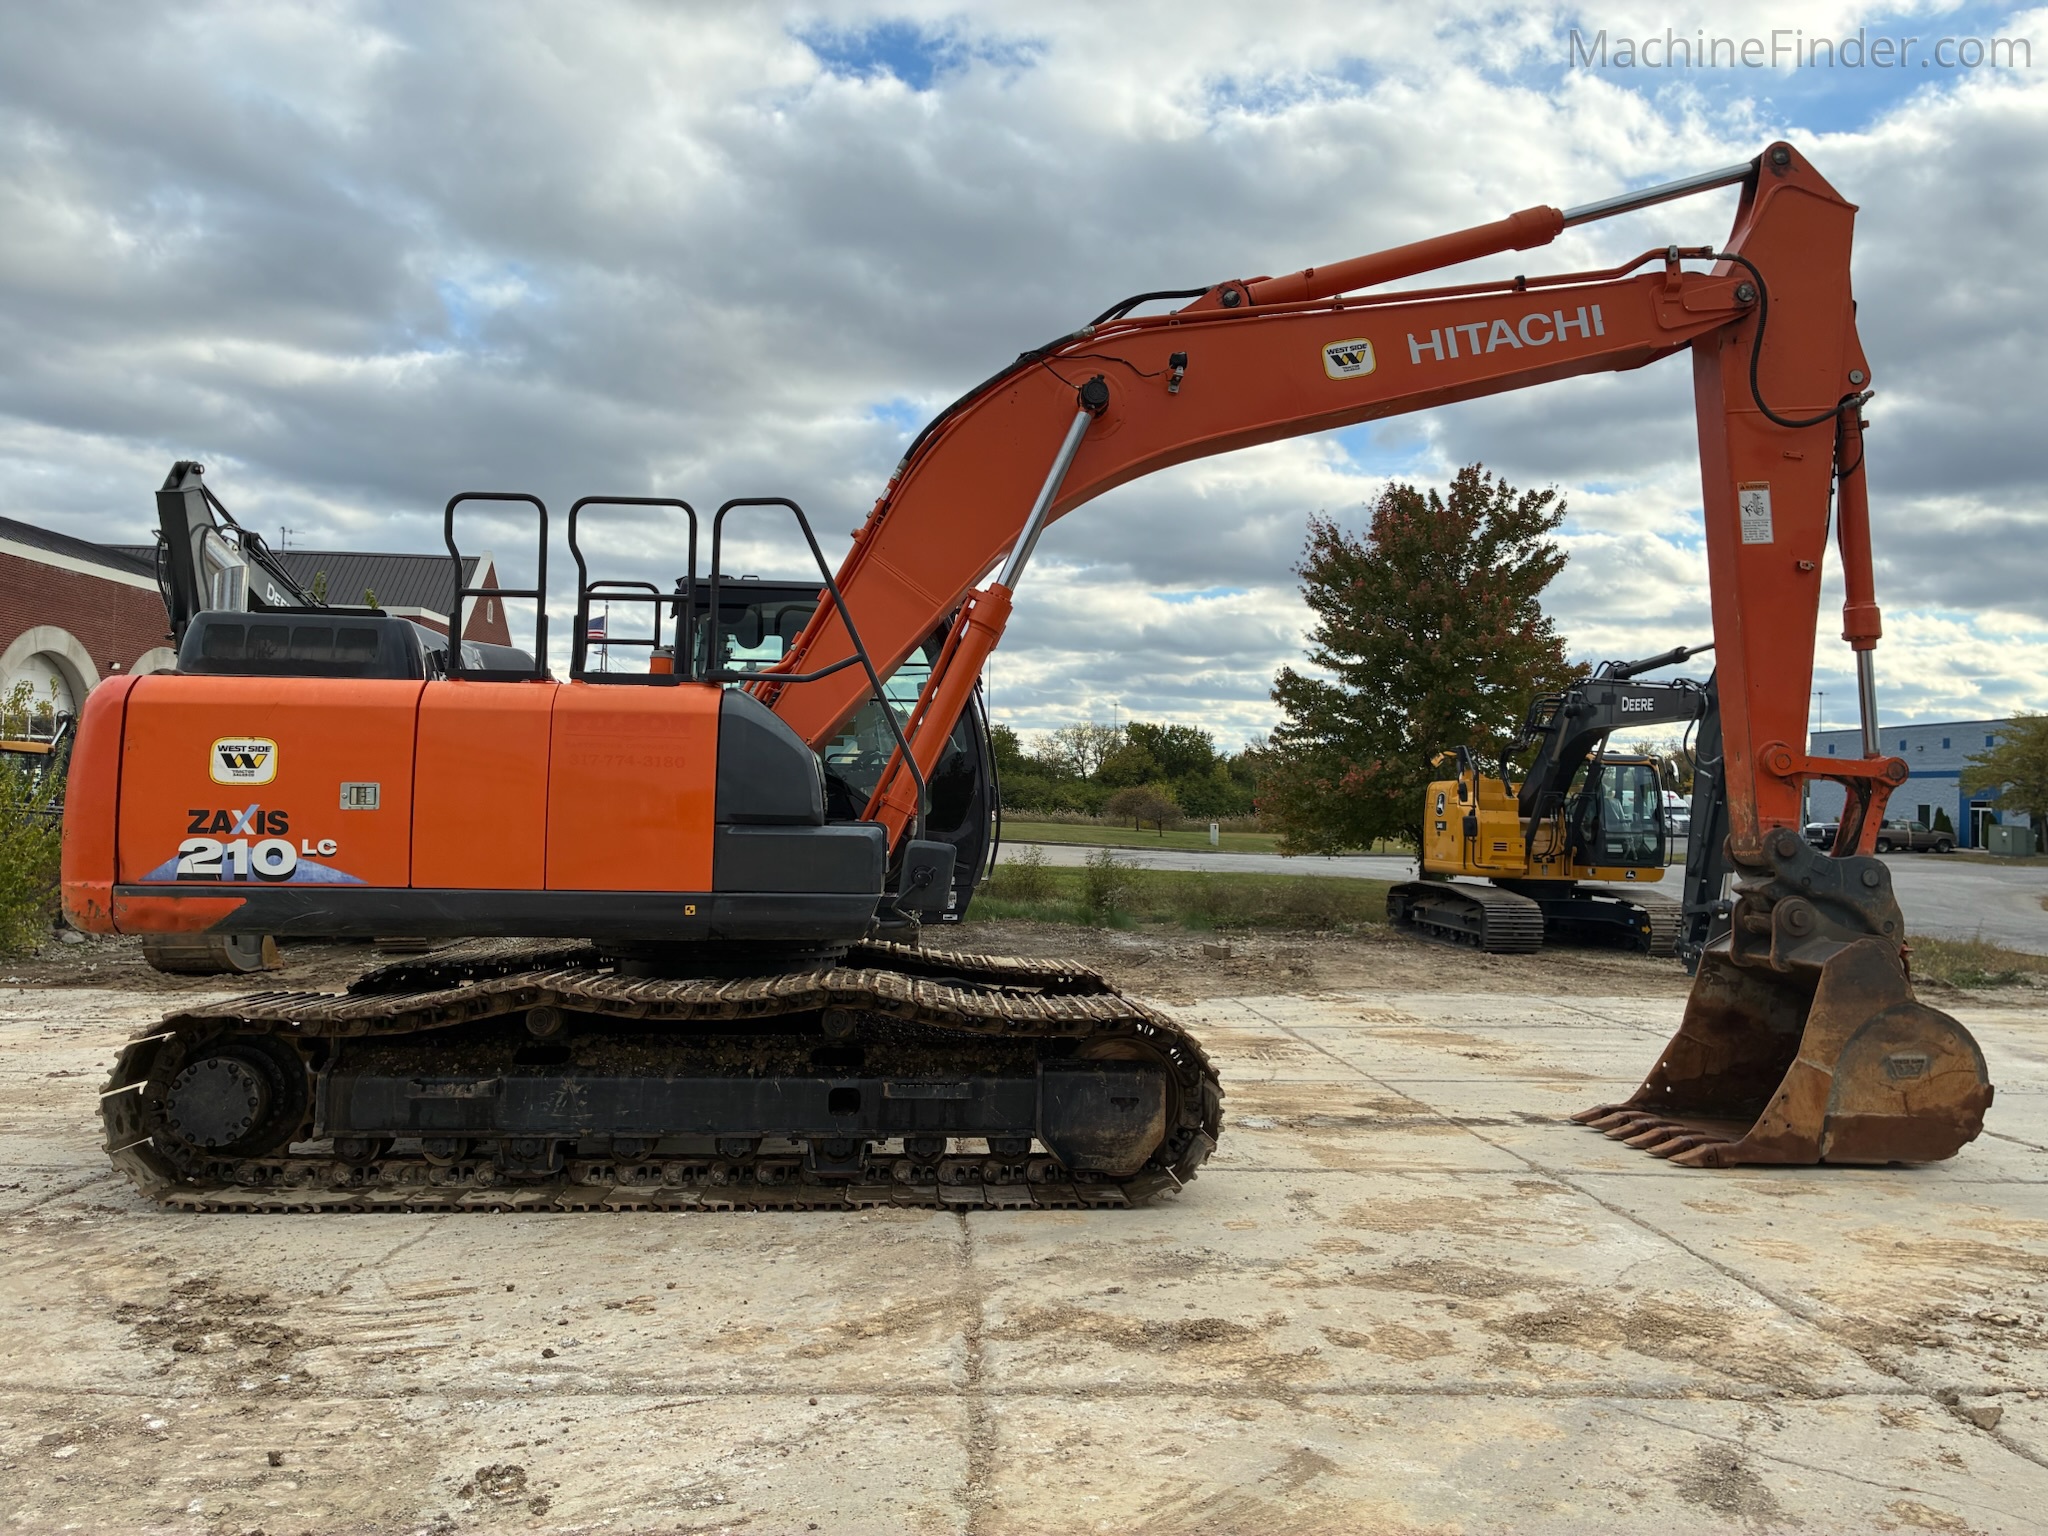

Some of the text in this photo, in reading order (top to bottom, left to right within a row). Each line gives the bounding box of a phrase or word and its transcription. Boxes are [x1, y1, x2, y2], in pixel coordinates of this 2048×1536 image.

[1407, 304, 1605, 364] HITACHI
[1326, 343, 1367, 355] WEST SIDE
[1621, 696, 1654, 712] DEERE
[569, 753, 686, 769] 317-774-3180
[187, 804, 289, 836] ZAXIS
[176, 838, 338, 881] 210 LC
